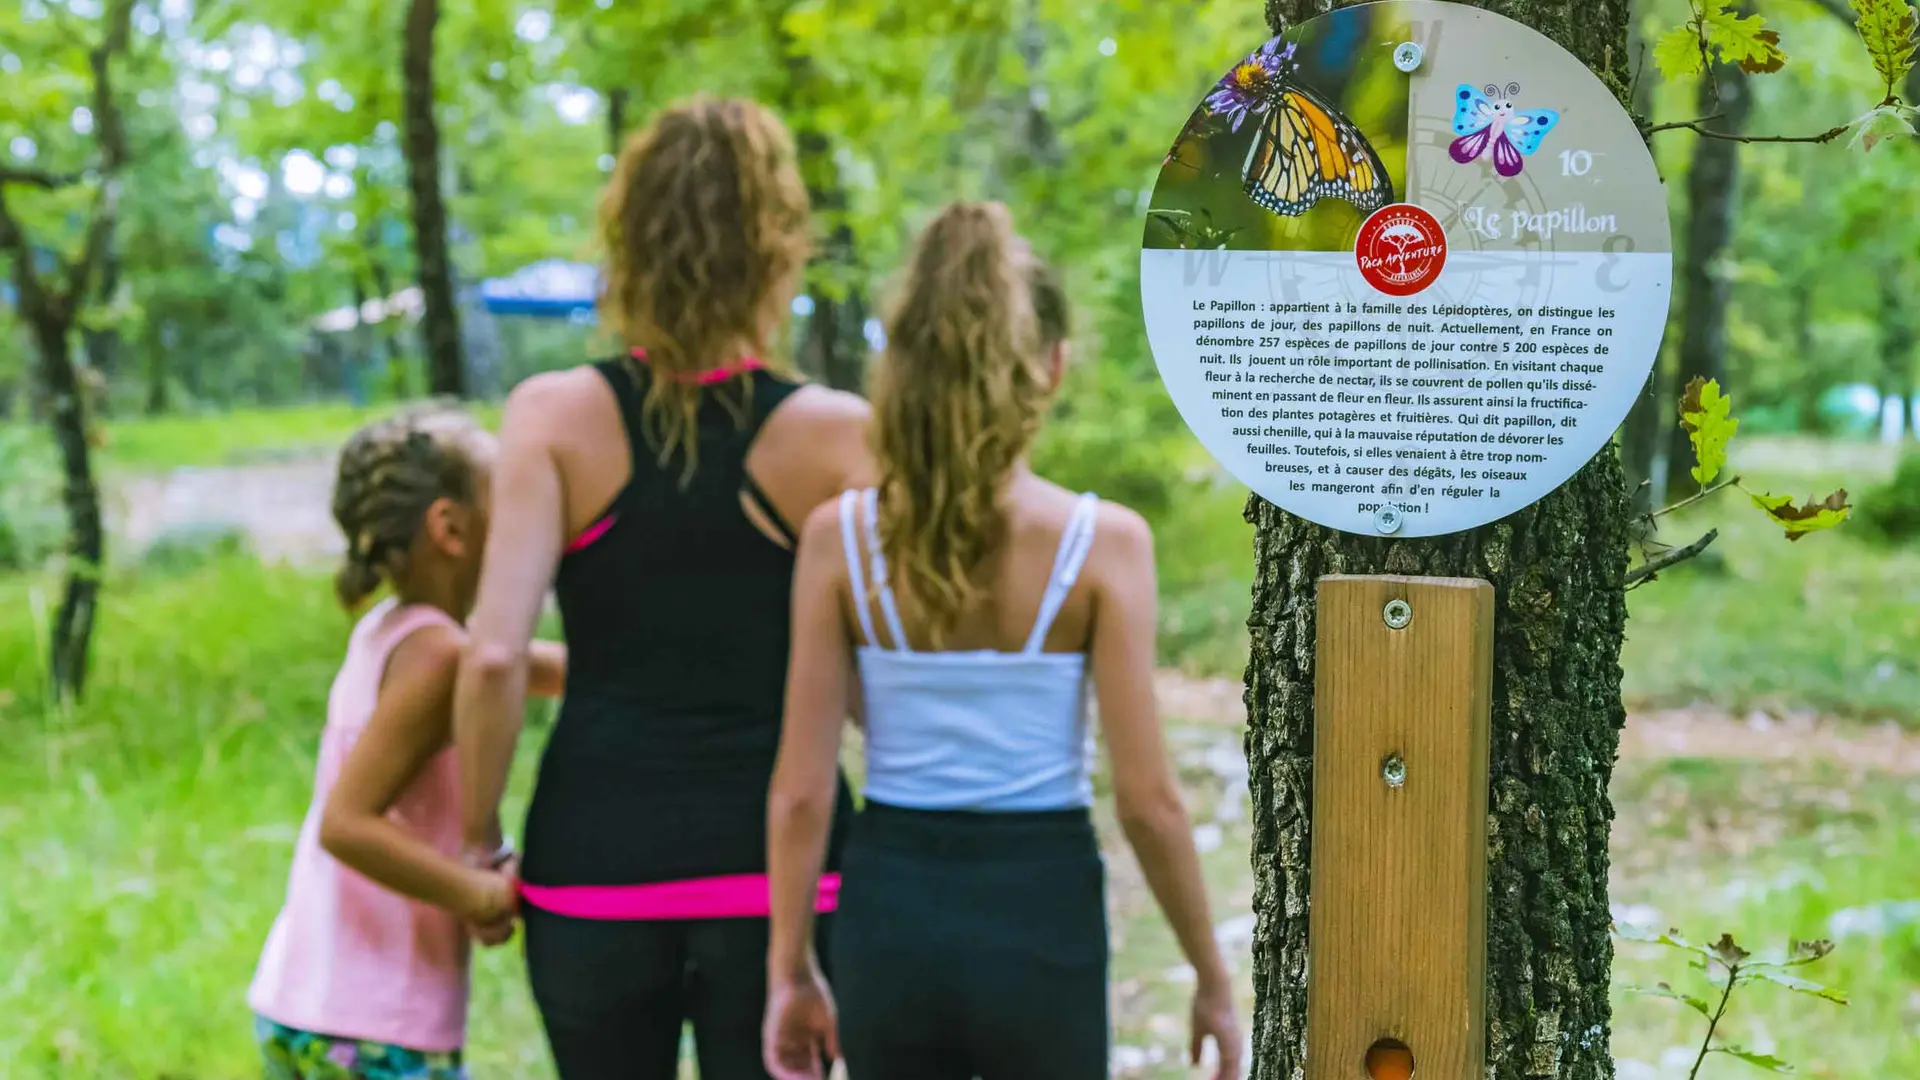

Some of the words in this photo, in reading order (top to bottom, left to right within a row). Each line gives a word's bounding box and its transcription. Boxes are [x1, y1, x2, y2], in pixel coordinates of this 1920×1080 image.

[1558, 150, 1592, 176] 10
[1464, 206, 1501, 239] Le
[1511, 205, 1617, 239] papillon
[1192, 298, 1206, 311] Le
[1210, 298, 1256, 315] Papillon
[1269, 301, 1330, 316] appartient
[1334, 300, 1342, 313] à
[1346, 300, 1357, 314] la
[1361, 301, 1402, 314] famille
[1406, 302, 1428, 315] des
[1432, 303, 1513, 320] Lépidoptères,
[1517, 307, 1533, 317] on
[1538, 304, 1593, 321] distingue
[1598, 305, 1615, 319] les
[1193, 315, 1246, 332] papillons
[1250, 316, 1266, 330] de
[1269, 318, 1297, 333] jour,
[1302, 317, 1323, 331] des
[1328, 318, 1382, 335] papillons
[1386, 319, 1402, 333] de
[1407, 321, 1435, 333] nuit.
[1440, 321, 1524, 336] Actuellement,
[1530, 326, 1545, 336] en
[1551, 323, 1591, 336] France
[1596, 327, 1613, 337] on
[1195, 333, 1255, 347] dénombre
[1258, 334, 1280, 348] 257
[1284, 335, 1330, 352] espèces
[1334, 336, 1350, 350] de
[1353, 337, 1407, 354] papillons
[1411, 338, 1426, 351] de
[1430, 340, 1456, 355] jour
[1459, 340, 1499, 353] contre
[1502, 340, 1510, 353] 5
[1514, 340, 1538, 354] 200
[1541, 341, 1590, 358] espèces
[1593, 342, 1609, 355] de
[1199, 352, 1226, 364] nuit.
[1229, 351, 1242, 365] Ils
[1247, 353, 1287, 369] jouent
[1289, 356, 1305, 366] un
[1307, 353, 1331, 367] rôle
[1333, 355, 1393, 371] important
[1395, 355, 1411, 369] de
[1414, 356, 1490, 373] pollinisation.
[1494, 358, 1509, 371] En
[1512, 359, 1557, 372] visitant
[1560, 359, 1604, 376] chaque
[1204, 369, 1232, 382] fleur
[1234, 369, 1242, 383] à
[1245, 370, 1256, 383] la
[1258, 370, 1316, 384] recherche
[1318, 371, 1334, 385] de
[1336, 373, 1377, 387] nectar,
[1378, 373, 1393, 386] ils
[1395, 377, 1409, 387] se
[1411, 375, 1464, 388] couvrent
[1467, 375, 1483, 389] de
[1486, 376, 1524, 393] pollen
[1526, 377, 1559, 394] qu'ils
[1562, 378, 1597, 391] dissé-
[1212, 388, 1253, 400] minent
[1255, 391, 1270, 401] en
[1273, 390, 1317, 405] passant
[1319, 389, 1334, 403] de
[1336, 390, 1366, 404] fleur
[1367, 394, 1382, 404] en
[1384, 391, 1414, 405] fleur.
[1417, 392, 1431, 406] Ils
[1432, 394, 1484, 407] assurent
[1486, 395, 1515, 408] ainsi
[1516, 395, 1528, 408] la
[1530, 396, 1588, 409] fructifica-
[1221, 406, 1244, 418] tion
[1248, 405, 1268, 419] des
[1272, 406, 1314, 423] plantes
[1318, 408, 1376, 425] potagères
[1380, 410, 1393, 422] et
[1396, 410, 1453, 424] fruitières.
[1458, 411, 1479, 427] Qui
[1483, 412, 1500, 425] dit
[1504, 413, 1556, 430] papillon,
[1560, 414, 1577, 428] dit
[1232, 424, 1261, 436] aussi
[1263, 424, 1312, 439] chenille,
[1313, 426, 1333, 442] qui
[1334, 426, 1342, 439] à
[1344, 426, 1356, 439] la
[1358, 428, 1413, 441] mauvaise
[1415, 429, 1478, 446] réputation
[1480, 430, 1496, 444] de
[1497, 431, 1545, 445] dévorer
[1547, 432, 1564, 446] les
[1246, 441, 1291, 455] feuilles.
[1294, 443, 1350, 458] Toutefois,
[1353, 445, 1364, 458] si
[1365, 445, 1393, 458] elles
[1395, 447, 1447, 460] venaient
[1449, 447, 1457, 460] à
[1460, 448, 1484, 461] être
[1487, 450, 1513, 465] trop
[1516, 453, 1548, 463] nom-
[1265, 460, 1313, 476] breuses,
[1317, 462, 1330, 475] et
[1334, 462, 1341, 475] à
[1345, 466, 1384, 476] causer
[1388, 463, 1409, 477] des
[1413, 465, 1456, 481] dégâts,
[1460, 466, 1477, 479] les
[1481, 468, 1527, 480] oiseaux
[1289, 478, 1306, 492] les
[1311, 481, 1376, 497] mangeront
[1380, 481, 1403, 495] afin
[1409, 482, 1435, 496] d'en
[1441, 483, 1484, 500] réguler
[1490, 485, 1500, 498] la
[1357, 499, 1421, 516] poption
